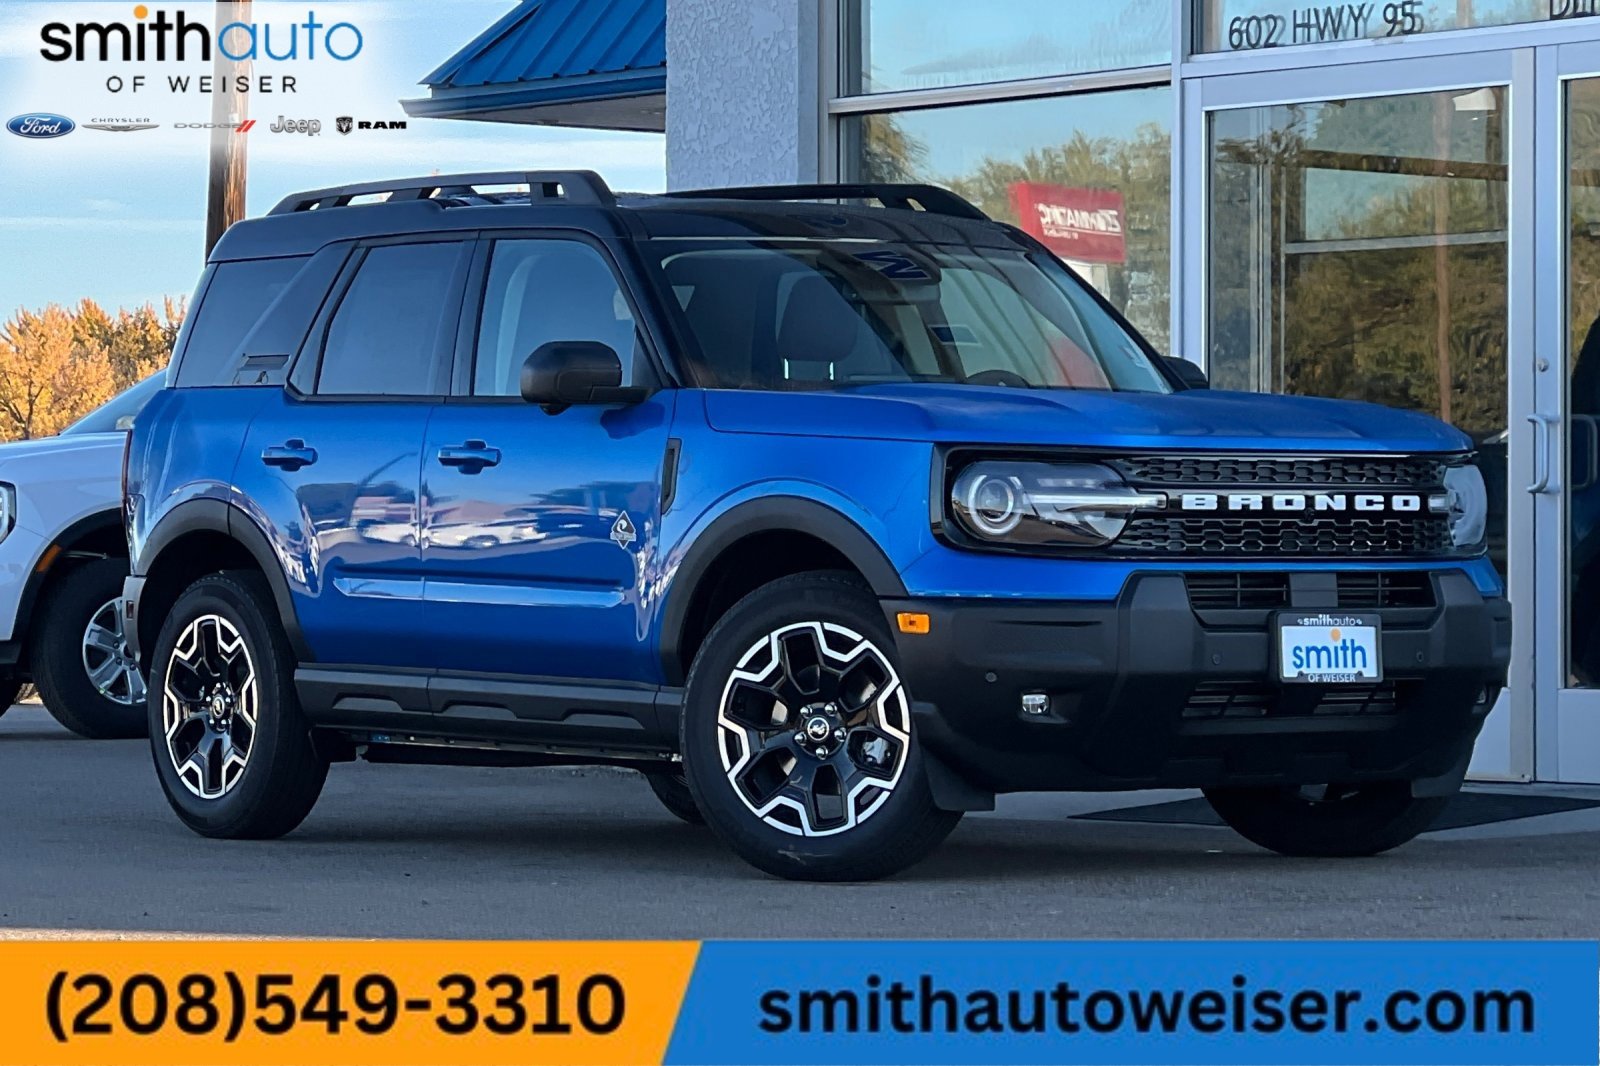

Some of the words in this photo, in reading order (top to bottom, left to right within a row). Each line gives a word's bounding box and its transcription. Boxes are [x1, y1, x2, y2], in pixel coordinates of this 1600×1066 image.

[1228, 14, 1279, 49] 602
[1292, 2, 1367, 43] HWY
[1382, 0, 1417, 37] 95
[1182, 494, 1420, 511] BRONCO
[1303, 614, 1356, 626] smithauto
[1292, 628, 1367, 669] smith
[1308, 673, 1321, 682] OF
[1322, 673, 1356, 682] WEISER
